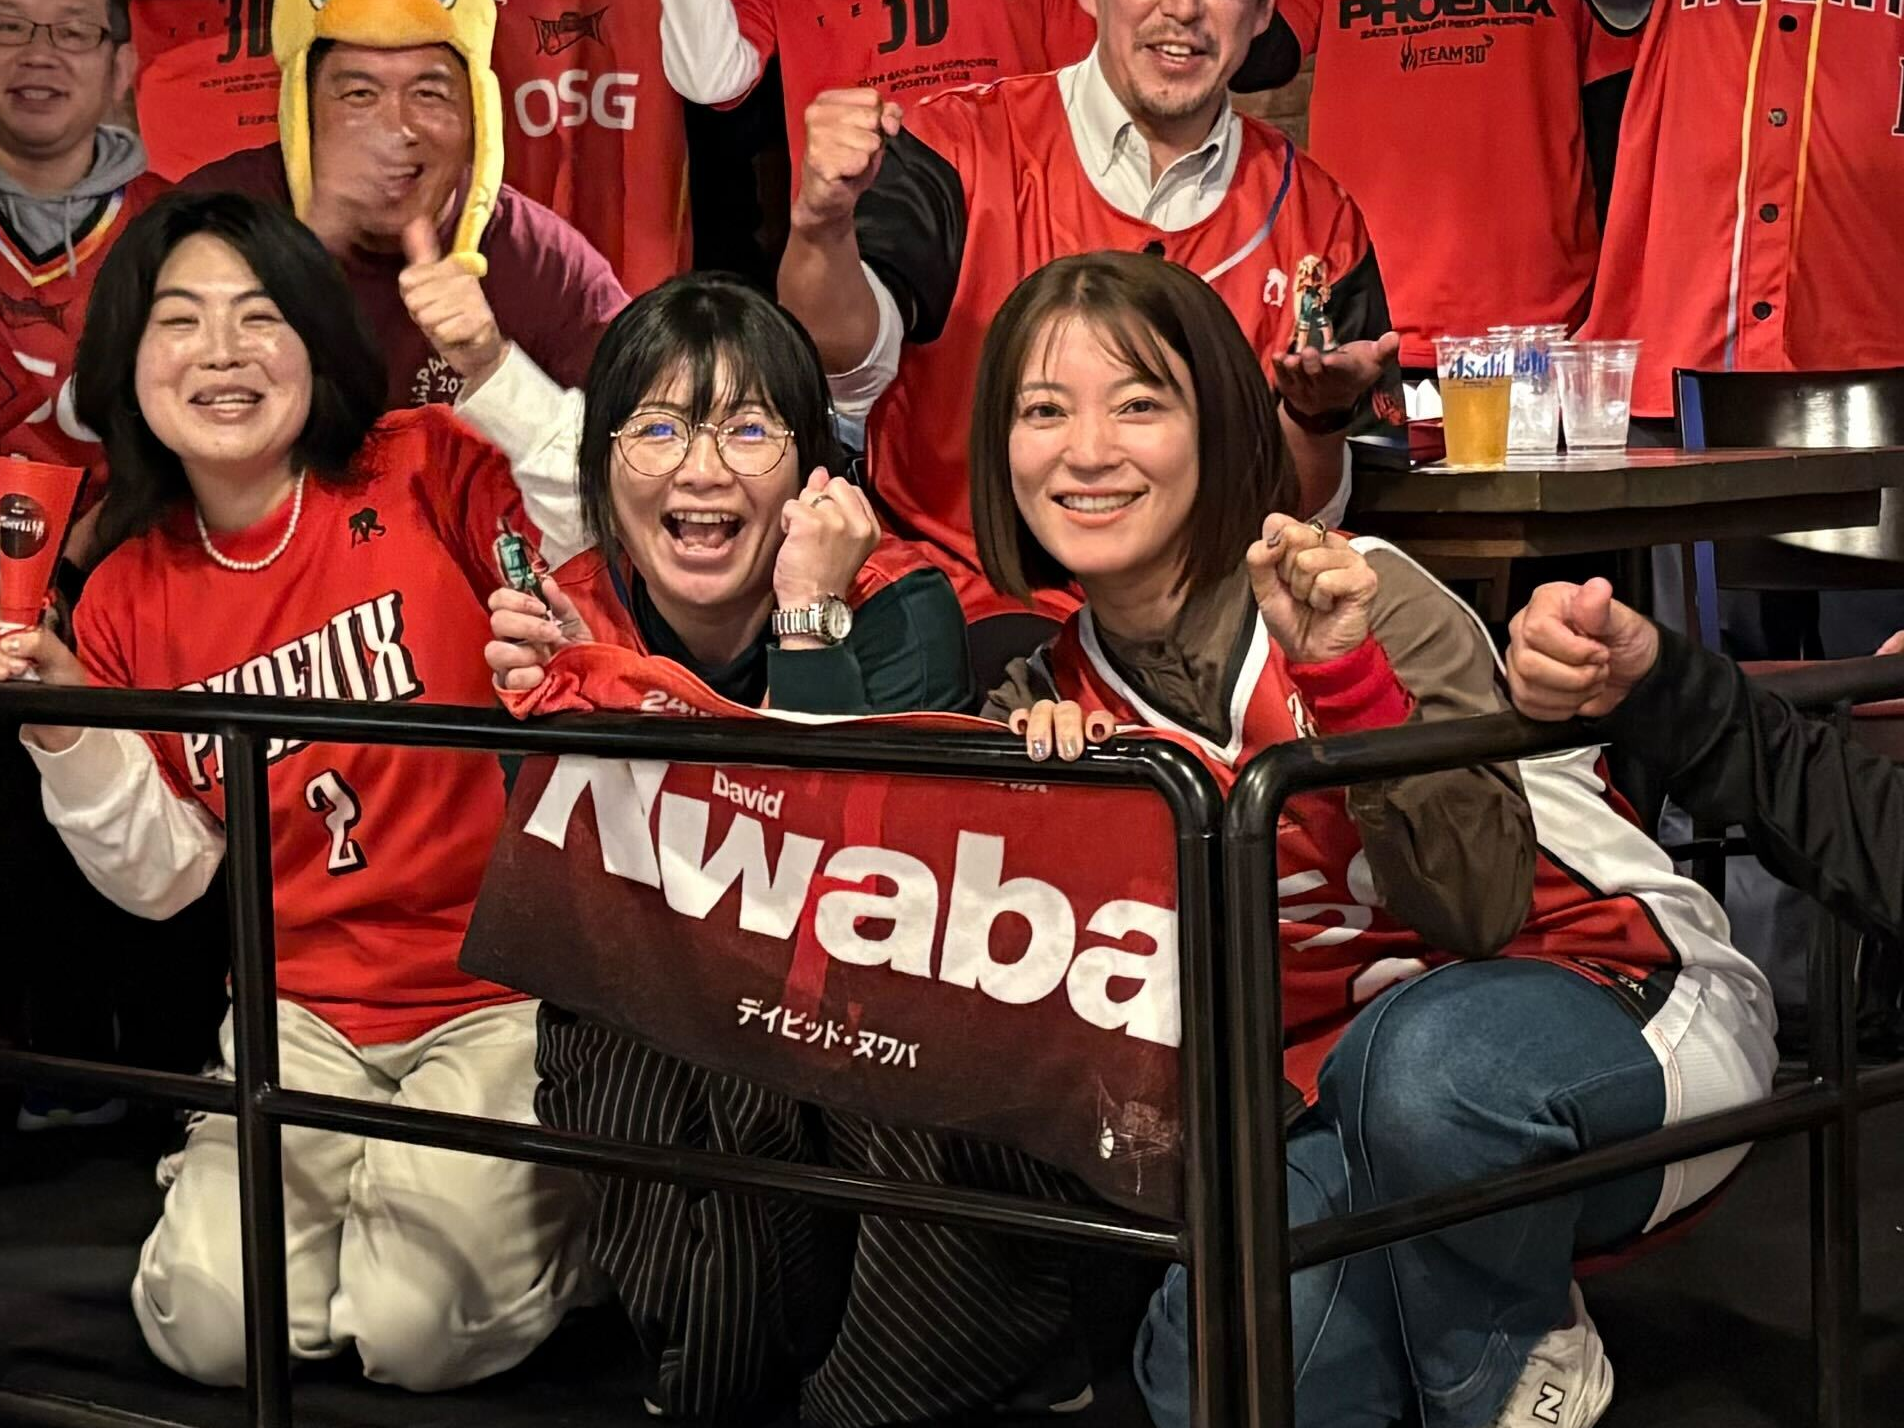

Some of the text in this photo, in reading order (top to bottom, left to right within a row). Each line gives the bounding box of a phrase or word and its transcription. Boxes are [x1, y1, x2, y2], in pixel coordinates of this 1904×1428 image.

[514, 69, 640, 138] OSG
[1448, 350, 1506, 380] Asahi
[304, 769, 368, 876] 2
[712, 770, 784, 820] David
[523, 754, 1181, 1049] Nwaba
